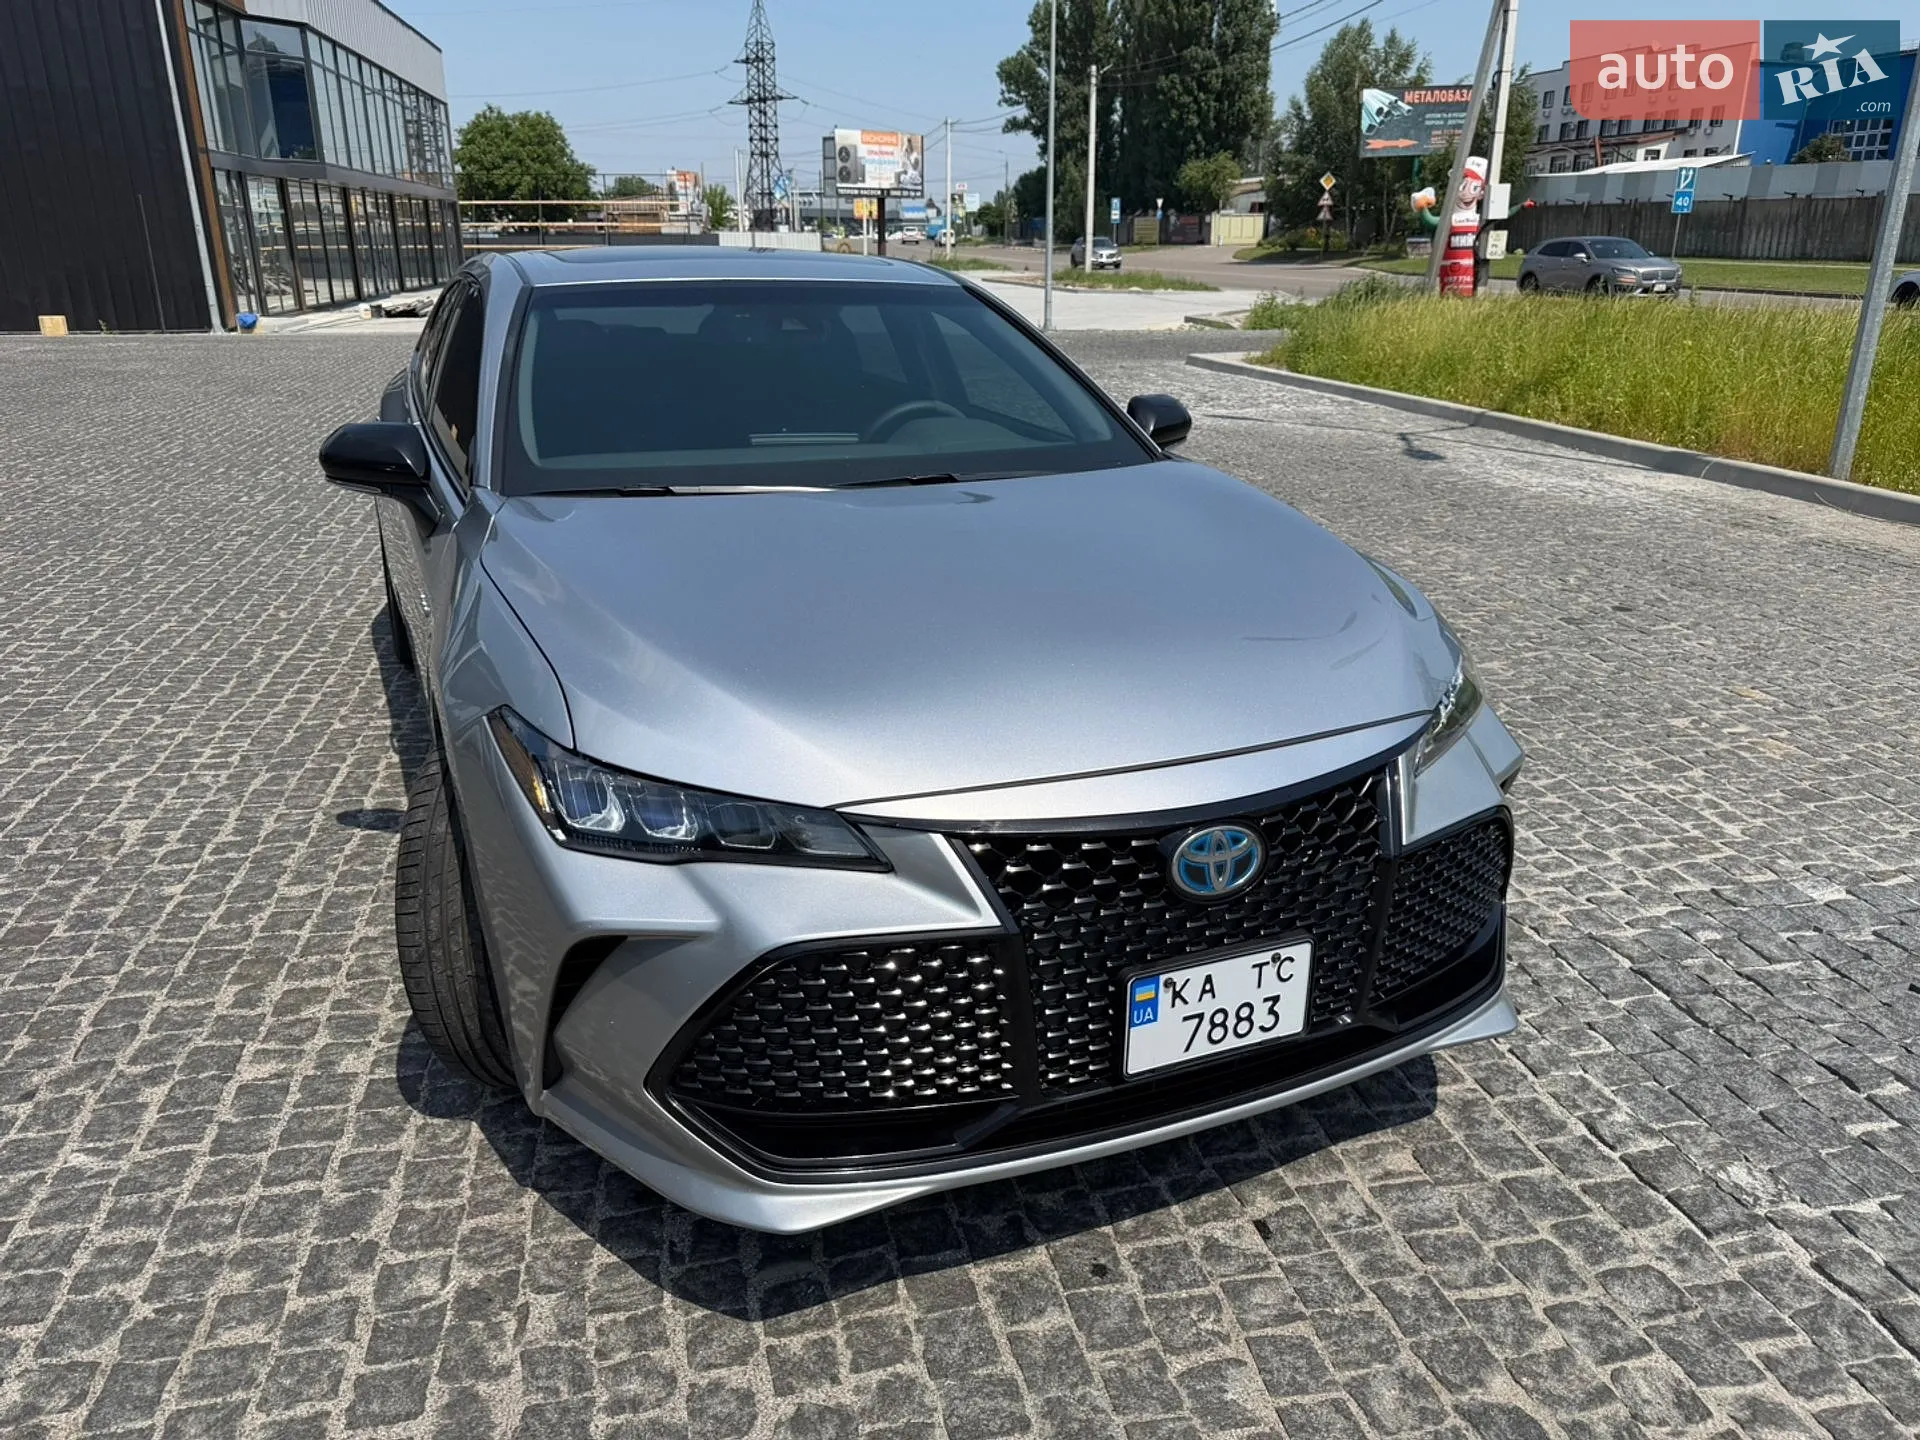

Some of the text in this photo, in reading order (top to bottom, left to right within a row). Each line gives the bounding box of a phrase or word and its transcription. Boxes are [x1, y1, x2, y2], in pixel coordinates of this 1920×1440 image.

[1676, 196, 1690, 206] 40
[1170, 956, 1295, 1008] KA TC
[1134, 1007, 1154, 1023] UA
[1182, 995, 1281, 1052] 7883
